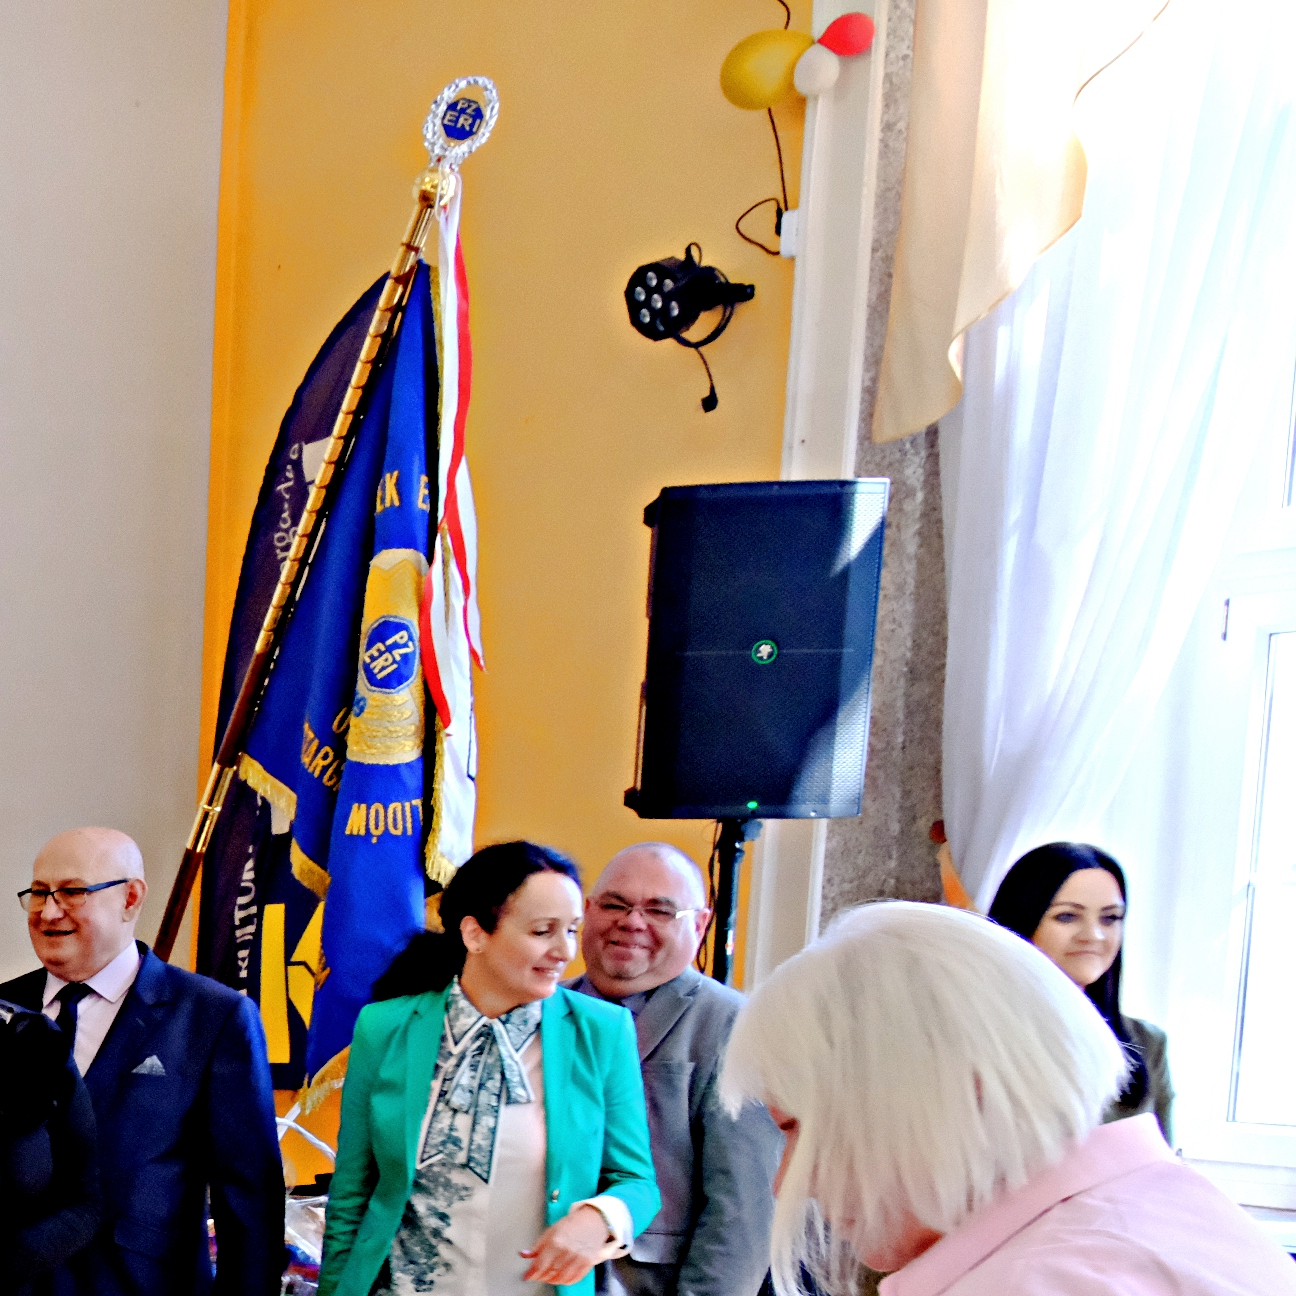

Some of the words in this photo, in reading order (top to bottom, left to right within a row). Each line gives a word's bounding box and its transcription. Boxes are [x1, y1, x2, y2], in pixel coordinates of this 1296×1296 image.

[456, 99, 479, 115] PZ
[443, 110, 481, 133] ERI
[385, 630, 415, 662] PZ
[364, 642, 398, 680] ERI
